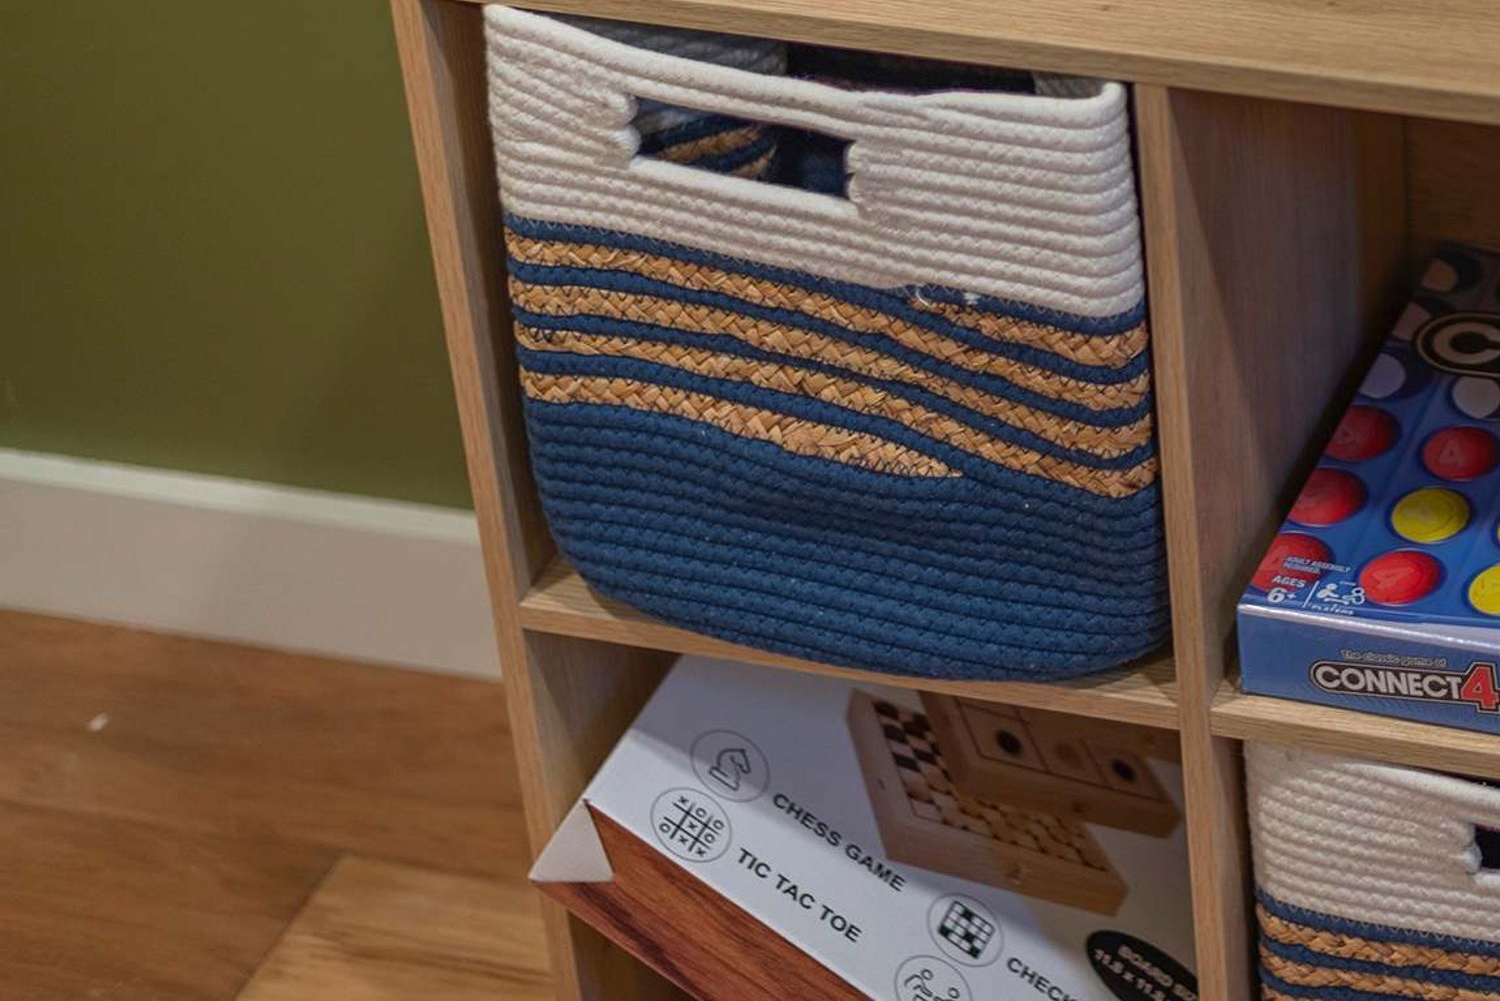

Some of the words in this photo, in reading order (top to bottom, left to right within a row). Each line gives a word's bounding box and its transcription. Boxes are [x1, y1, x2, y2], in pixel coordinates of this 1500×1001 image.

[1267, 587, 1297, 603] 6+
[1272, 575, 1306, 588] AGES
[1315, 665, 1462, 699] CONNECT
[1461, 665, 1500, 709] 4
[773, 794, 842, 847] CHESS
[844, 844, 906, 892] GAME
[738, 848, 772, 879] TIC
[775, 874, 816, 910] TAC
[819, 905, 863, 943] TOE
